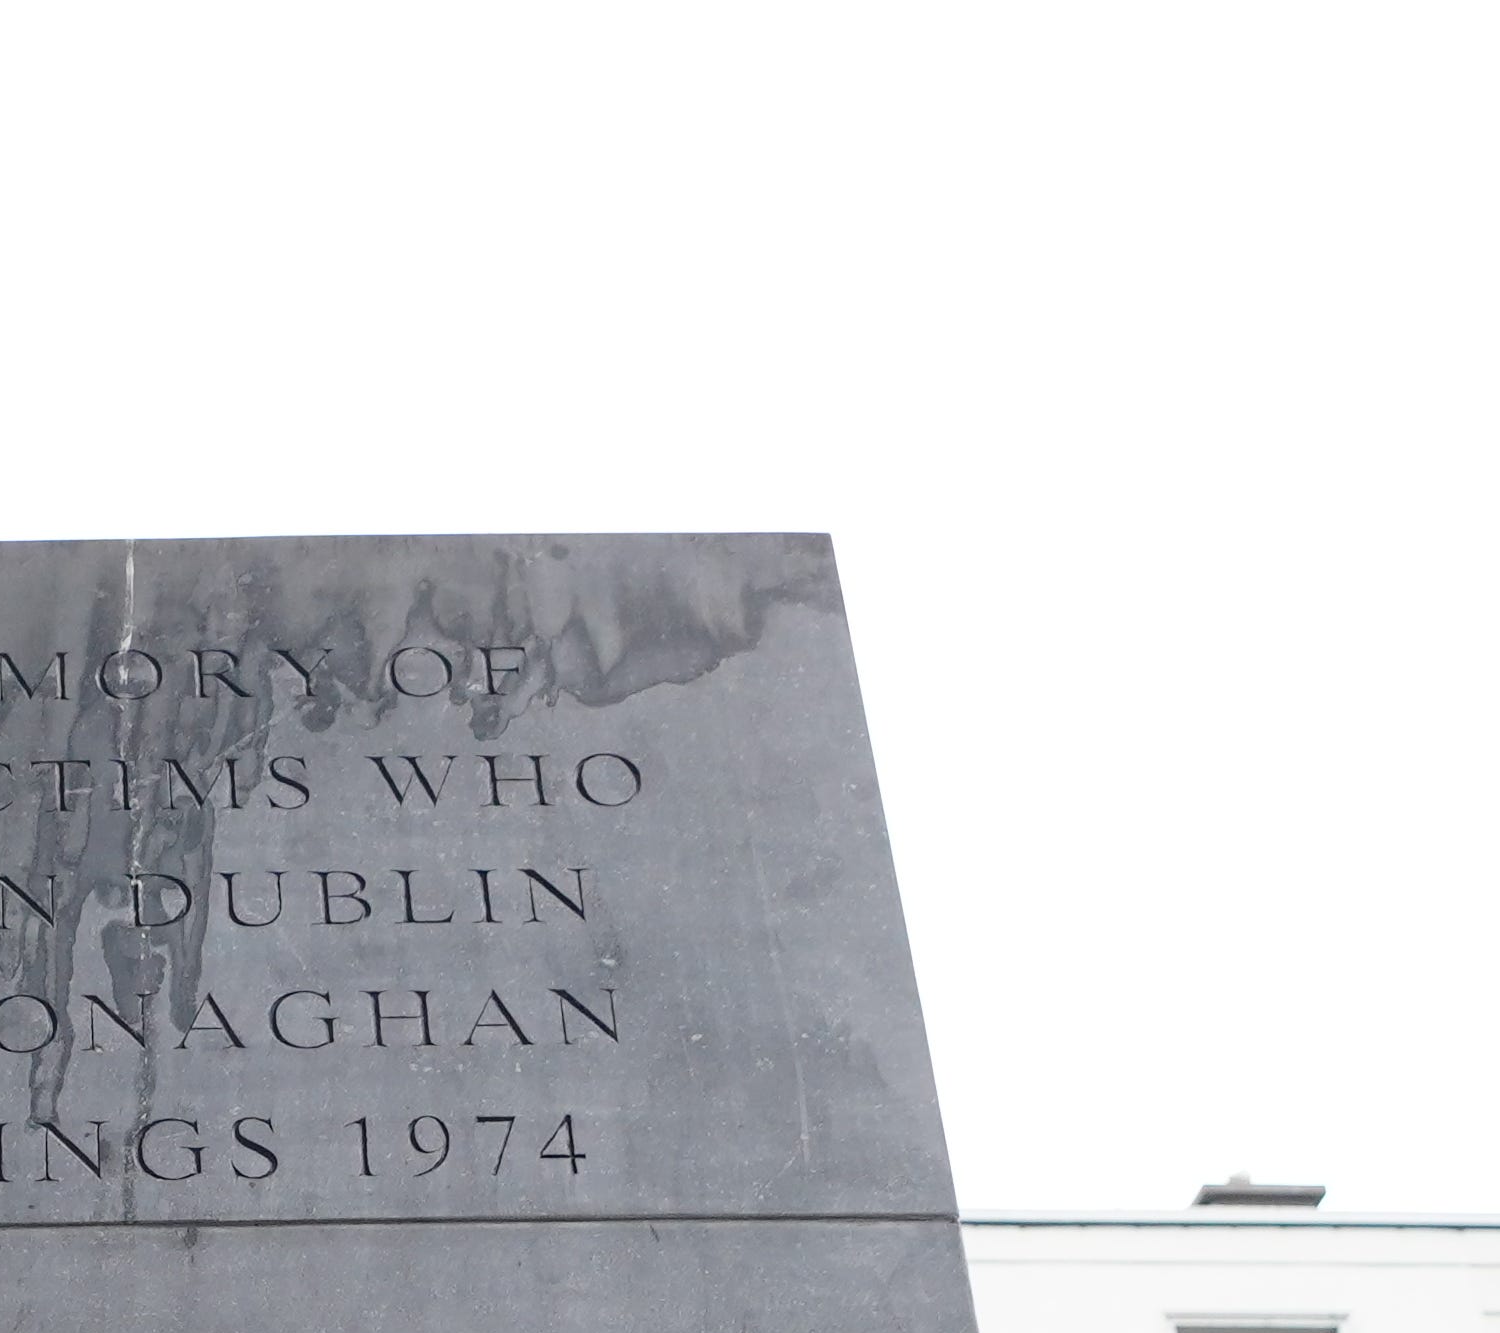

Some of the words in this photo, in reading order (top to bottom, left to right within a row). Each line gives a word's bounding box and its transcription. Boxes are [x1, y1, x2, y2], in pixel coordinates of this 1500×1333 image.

[389, 646, 529, 698] OF
[367, 752, 643, 807] WHO
[127, 867, 593, 930] DUBLIN
[352, 1115, 588, 1178] 1974
